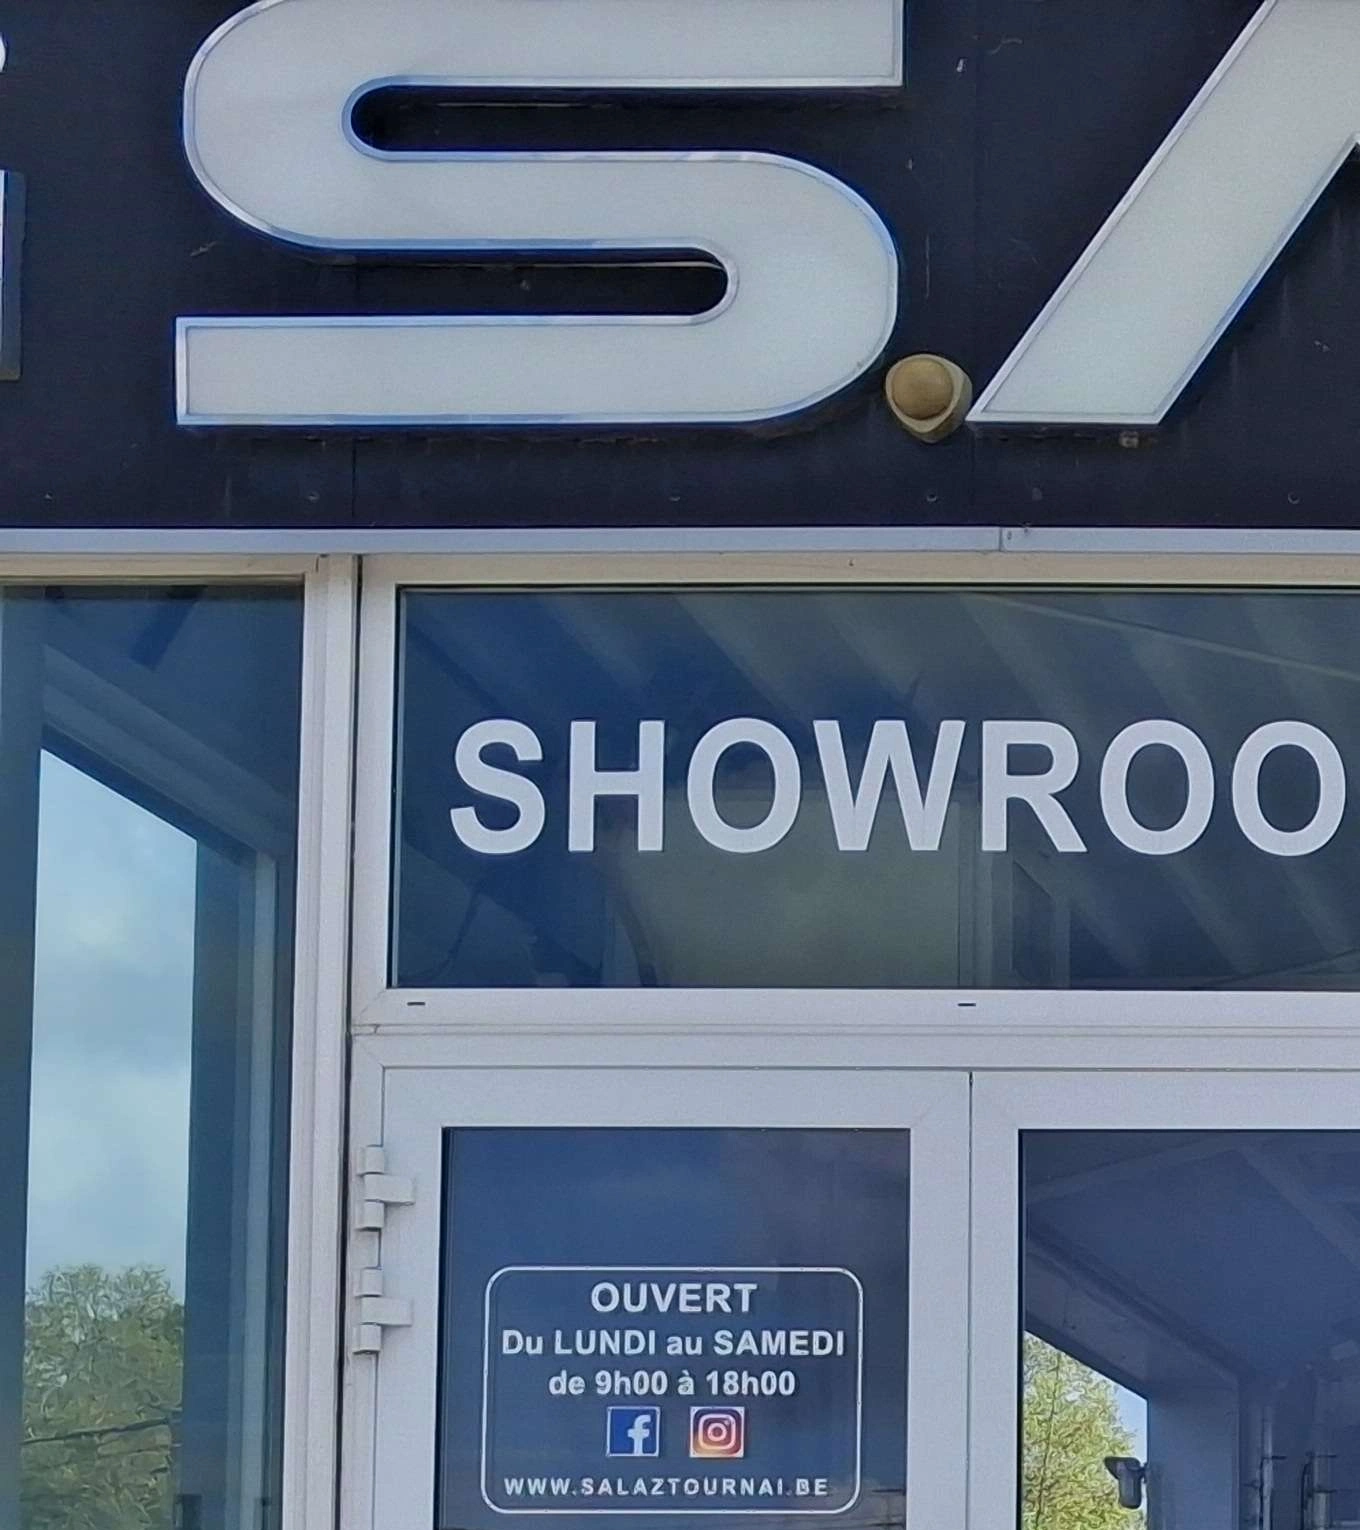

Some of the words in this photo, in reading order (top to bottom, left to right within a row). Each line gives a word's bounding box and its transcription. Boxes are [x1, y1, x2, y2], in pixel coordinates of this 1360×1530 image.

[590, 1282, 757, 1314] OUVERT
[502, 1330, 543, 1356] Du
[553, 1330, 656, 1356] LUNDI
[666, 1334, 703, 1356] au
[713, 1330, 845, 1357] SAMEDI
[548, 1371, 586, 1396] de
[595, 1370, 668, 1396] 9h00
[677, 1368, 695, 1396] à
[705, 1370, 796, 1396] 18h00
[504, 1476, 828, 1497] WWW.SALAZTOURNAI.BE
